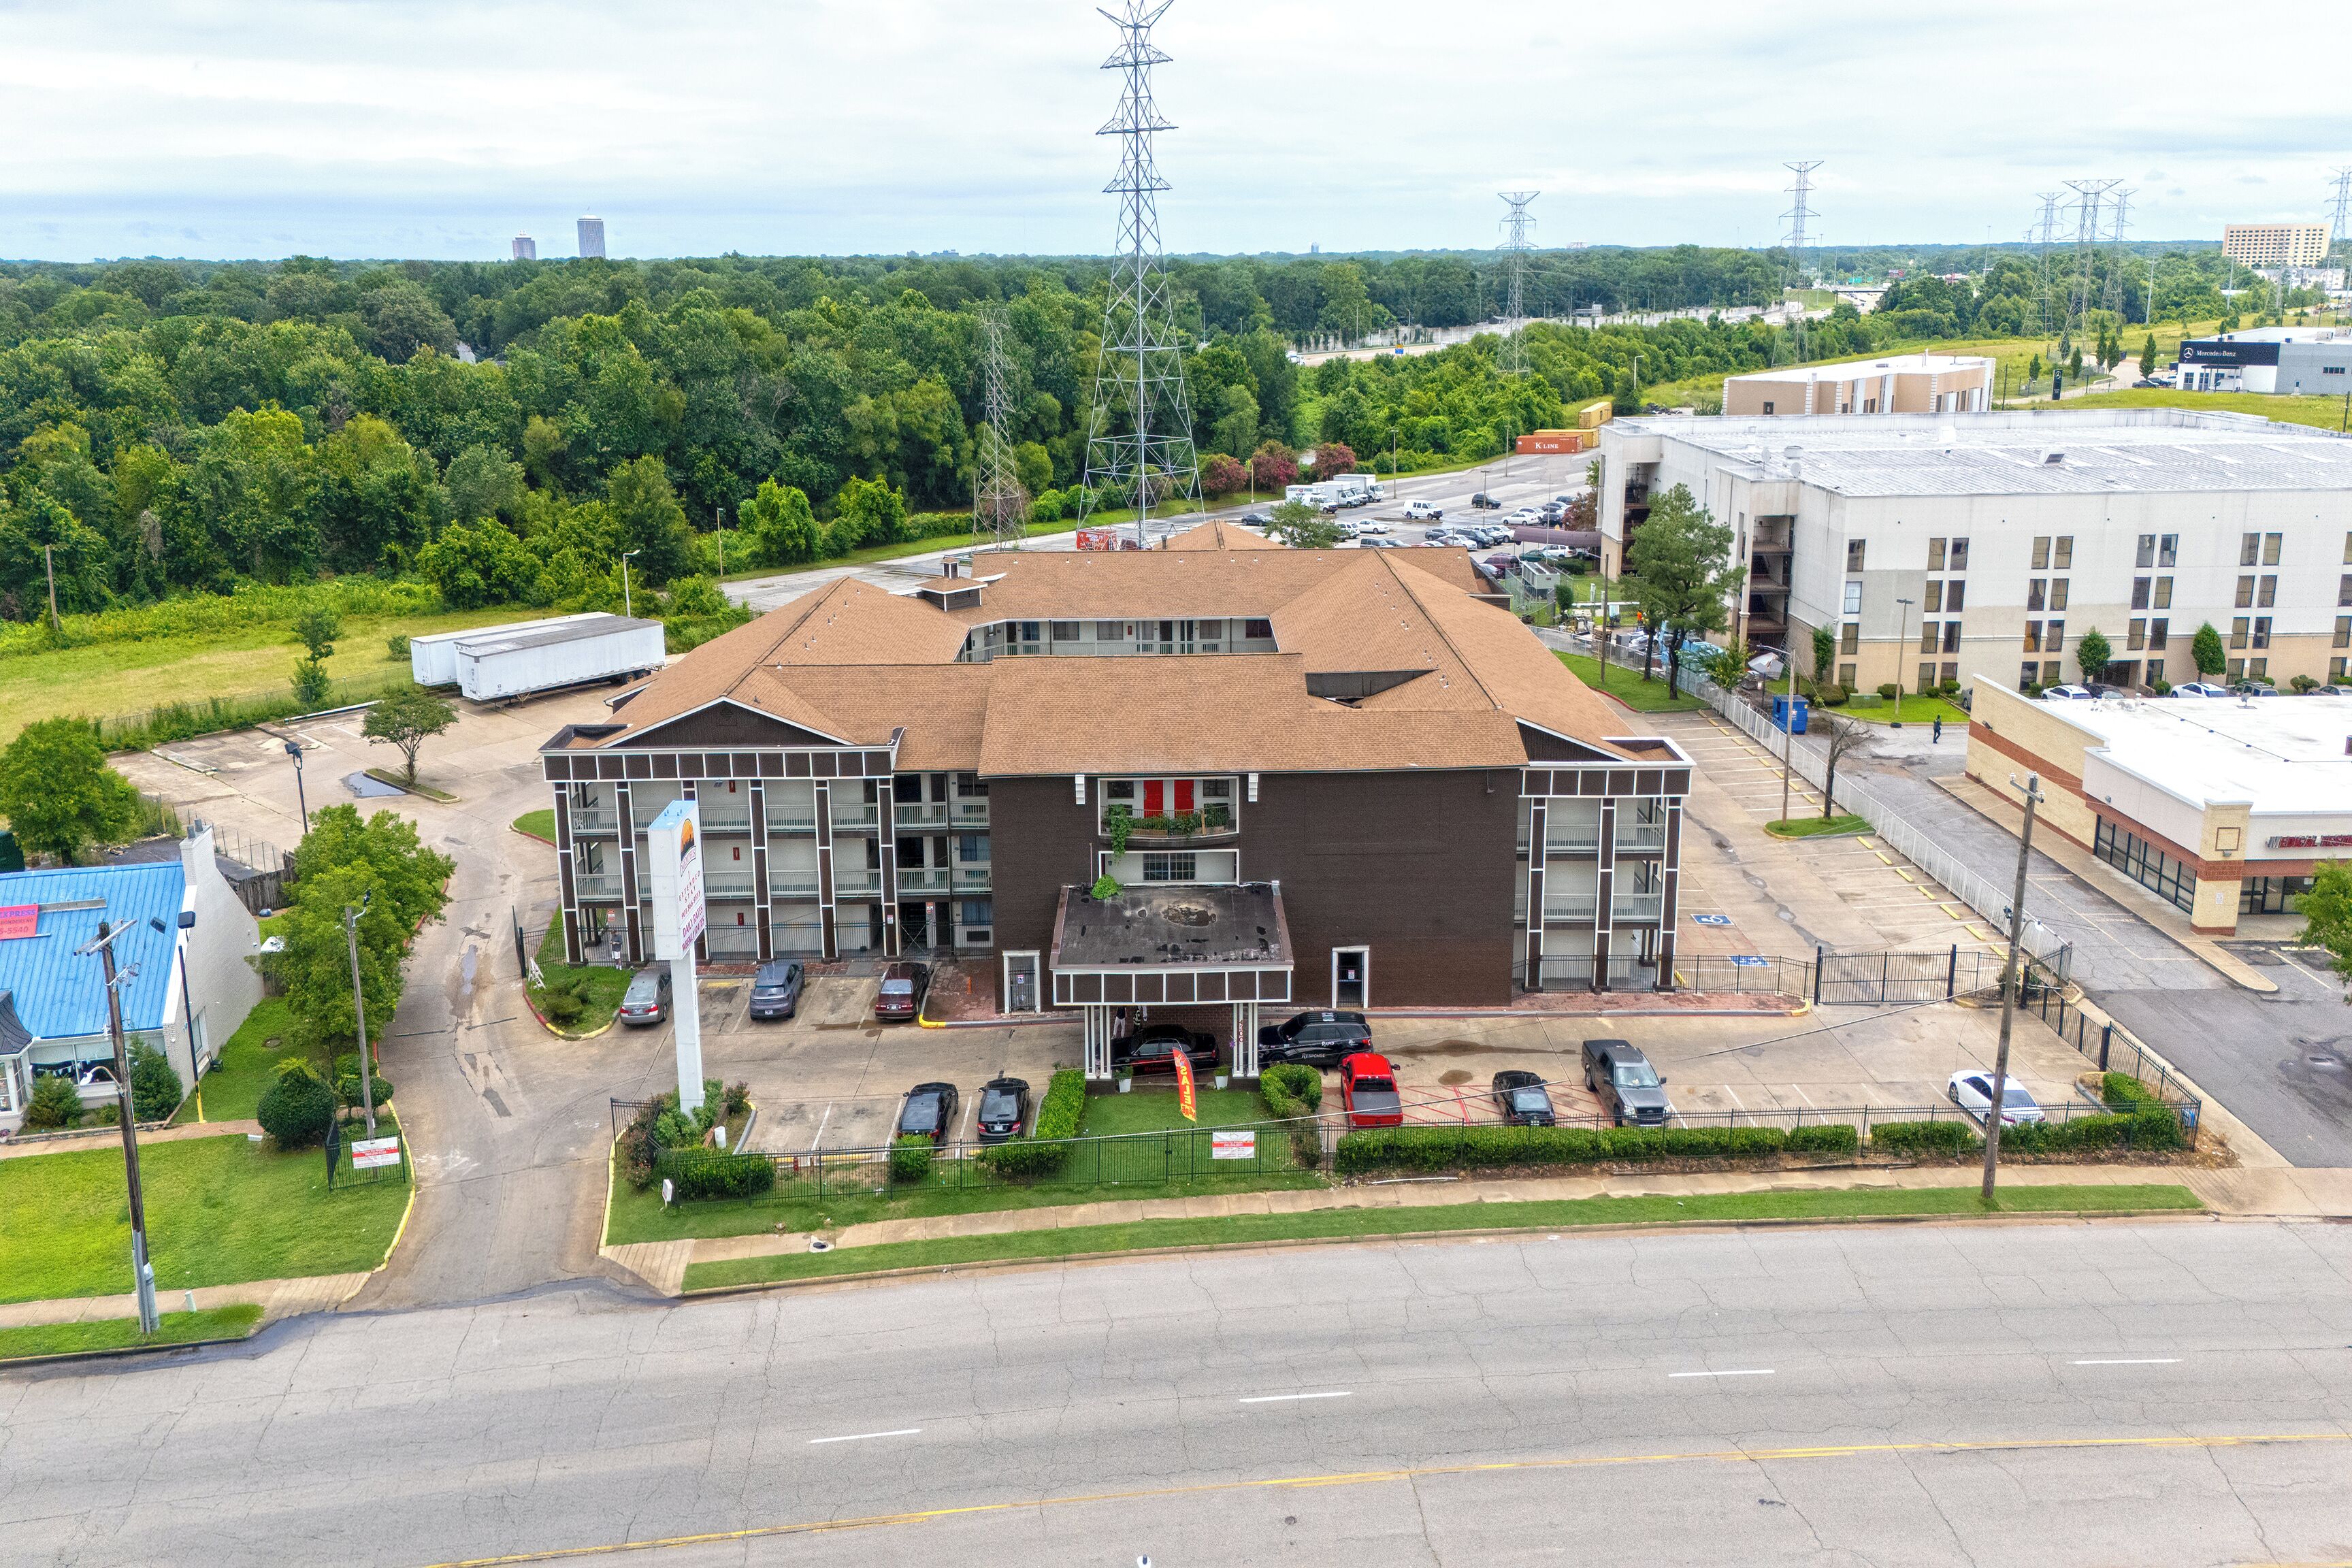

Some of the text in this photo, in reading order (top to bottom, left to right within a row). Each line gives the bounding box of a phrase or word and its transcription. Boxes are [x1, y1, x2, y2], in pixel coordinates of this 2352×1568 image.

[2266, 835, 2318, 848] MEDICAL
[681, 847, 696, 871] MEMPHIS
[679, 870, 700, 902] EXTENDED
[685, 885, 696, 904] STAY
[0, 909, 36, 918] EXPRESS
[683, 904, 703, 938] DAILY RATES
[682, 915, 704, 951] WEEKLY RATES
